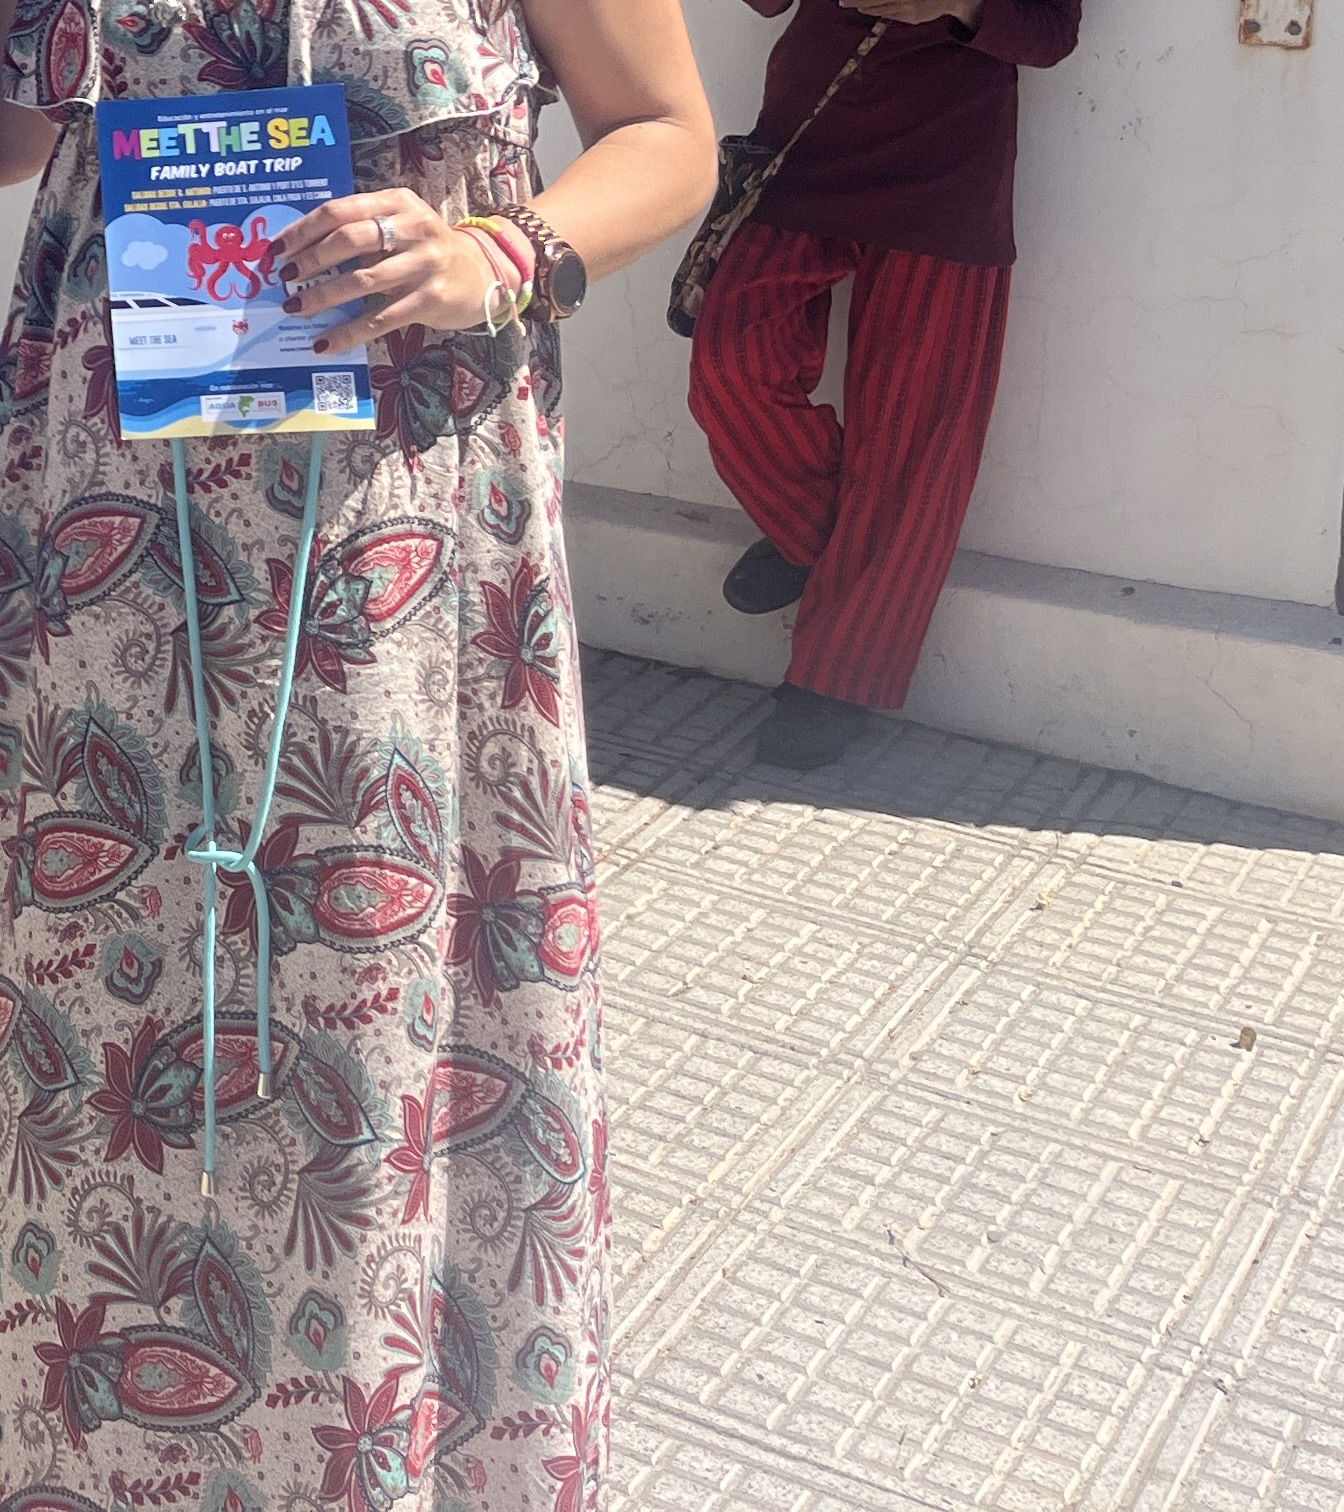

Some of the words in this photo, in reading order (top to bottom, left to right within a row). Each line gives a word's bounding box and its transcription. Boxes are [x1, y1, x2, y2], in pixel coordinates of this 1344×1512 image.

[266, 114, 336, 150] SEA
[150, 163, 211, 181] FAMILY
[214, 160, 260, 177] BOAT
[263, 157, 303, 173] TRIP
[164, 334, 177, 344] SEA
